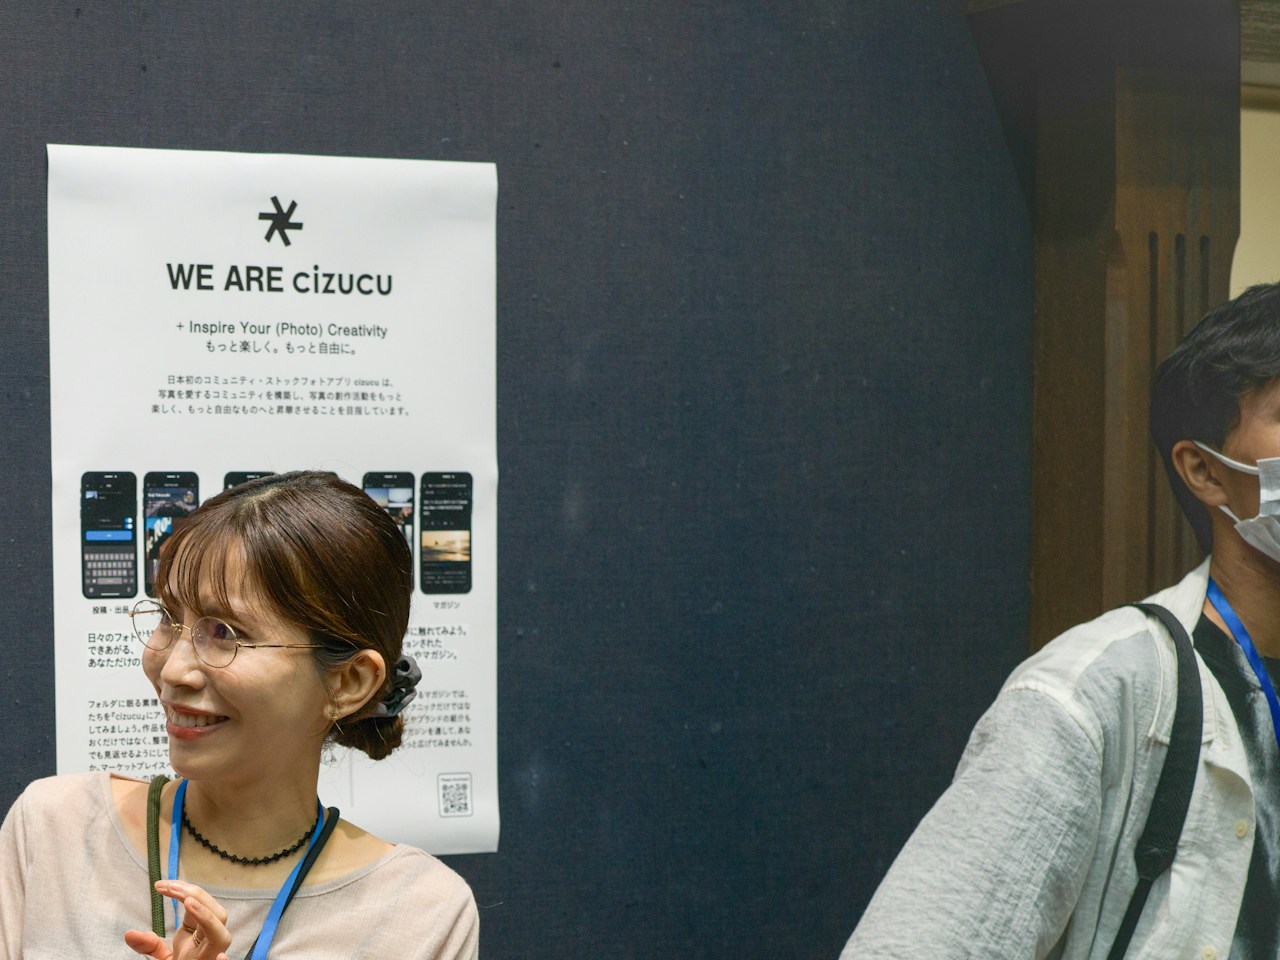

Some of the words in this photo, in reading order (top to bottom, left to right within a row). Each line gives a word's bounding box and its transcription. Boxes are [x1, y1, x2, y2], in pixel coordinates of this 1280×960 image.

[165, 262, 215, 291] WE
[223, 264, 284, 293] ARE
[292, 264, 393, 296] cizucu
[189, 320, 236, 336] Inspire
[239, 321, 272, 335] Your
[275, 321, 324, 338] (Photo)
[327, 322, 388, 340] Creativity
[205, 339, 356, 356] もっと楽しく。もっと自由に。
